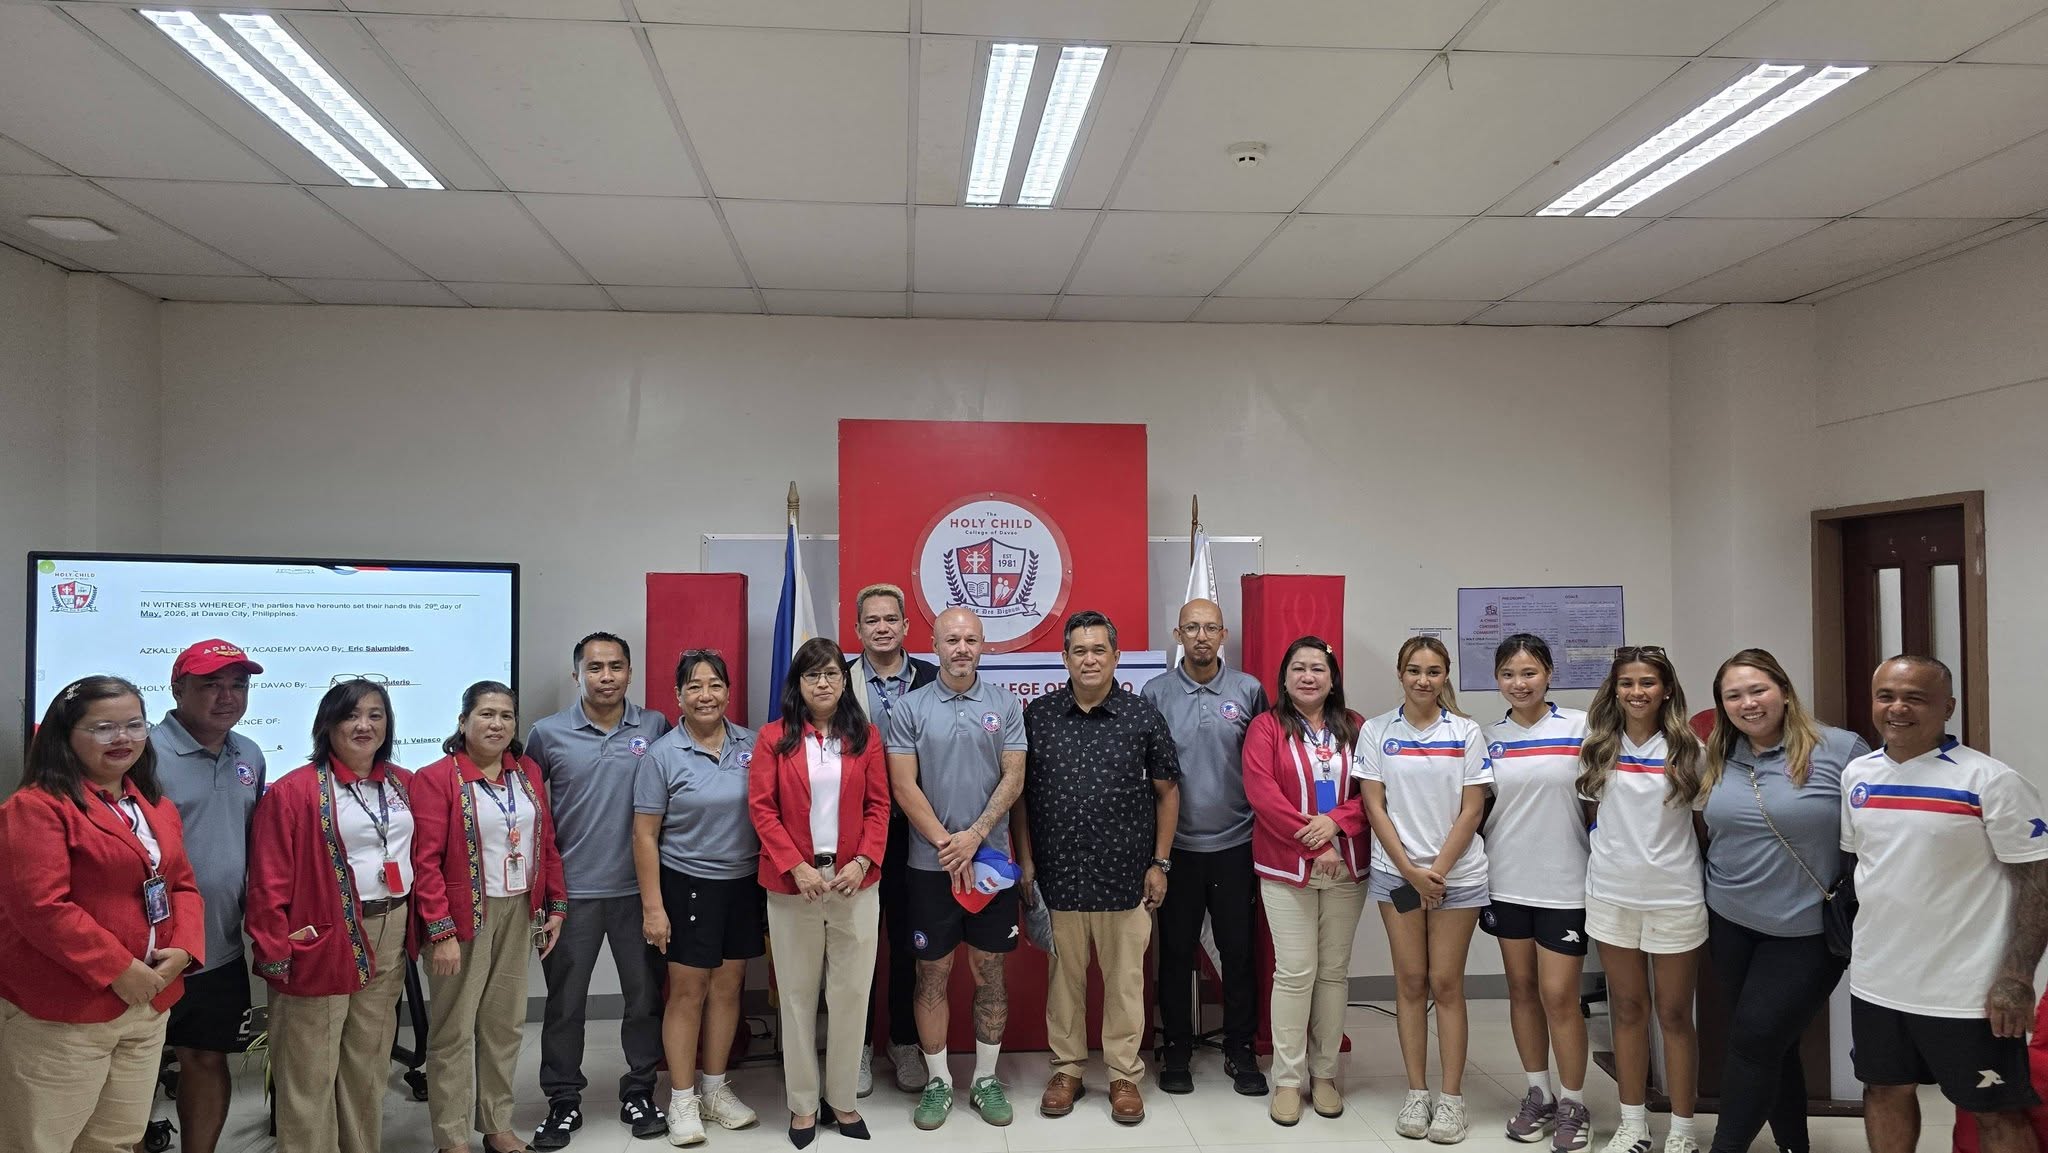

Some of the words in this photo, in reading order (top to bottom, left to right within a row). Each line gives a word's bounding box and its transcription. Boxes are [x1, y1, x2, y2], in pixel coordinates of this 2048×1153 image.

[950, 518, 986, 528] HOLY
[991, 519, 1032, 528] CHILD
[998, 560, 1016, 568] 1981
